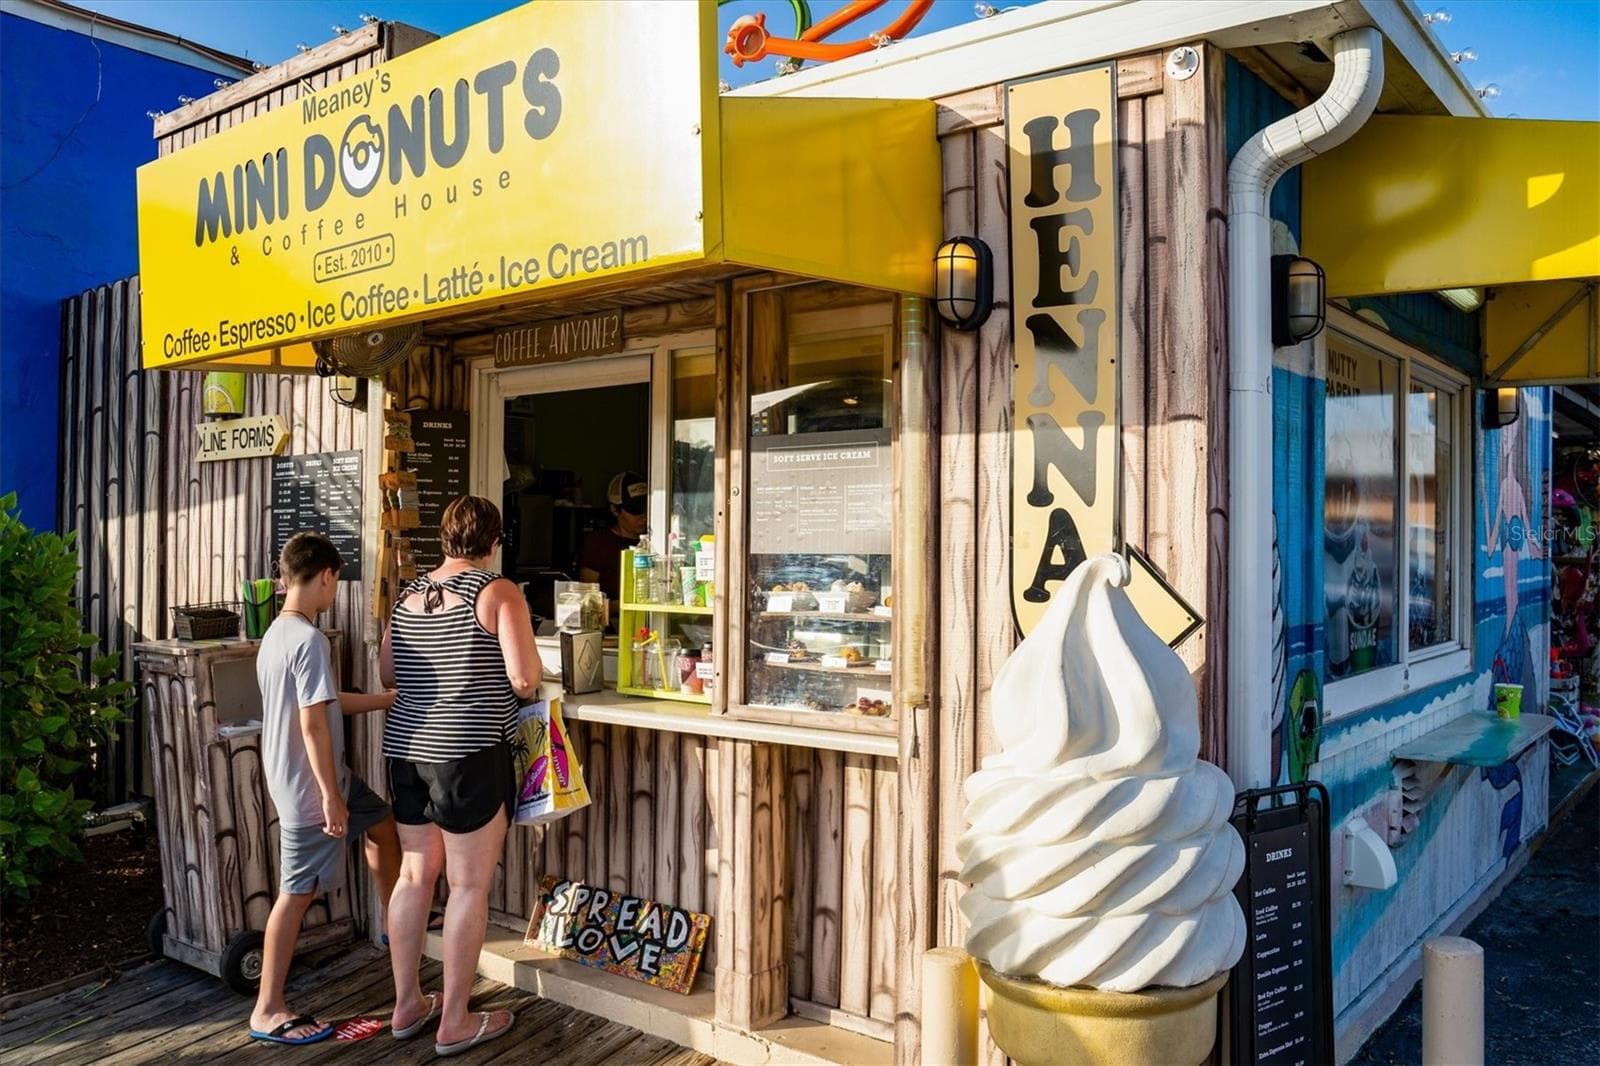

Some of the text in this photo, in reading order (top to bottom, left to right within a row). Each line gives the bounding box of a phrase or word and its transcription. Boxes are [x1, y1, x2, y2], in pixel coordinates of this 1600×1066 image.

[302, 70, 392, 125] Meaney's
[195, 47, 562, 247] MINI DONUTS
[231, 170, 510, 266] & Coffee House
[325, 243, 382, 274] Est. 2010
[163, 234, 648, 358] Coffee Espresso Ice Coffee Latté Ice Cream
[495, 315, 619, 363] COFFEE, ANYONE?
[1022, 108, 1107, 605] HENNA
[1328, 349, 1357, 381] NUTTY
[202, 425, 275, 452] LINE FORMS
[823, 452, 838, 461] ICE
[840, 450, 872, 459] CREAM
[1265, 848, 1293, 862] DRINKS
[549, 880, 691, 950] SPREAD
[554, 915, 663, 976] LOVE
